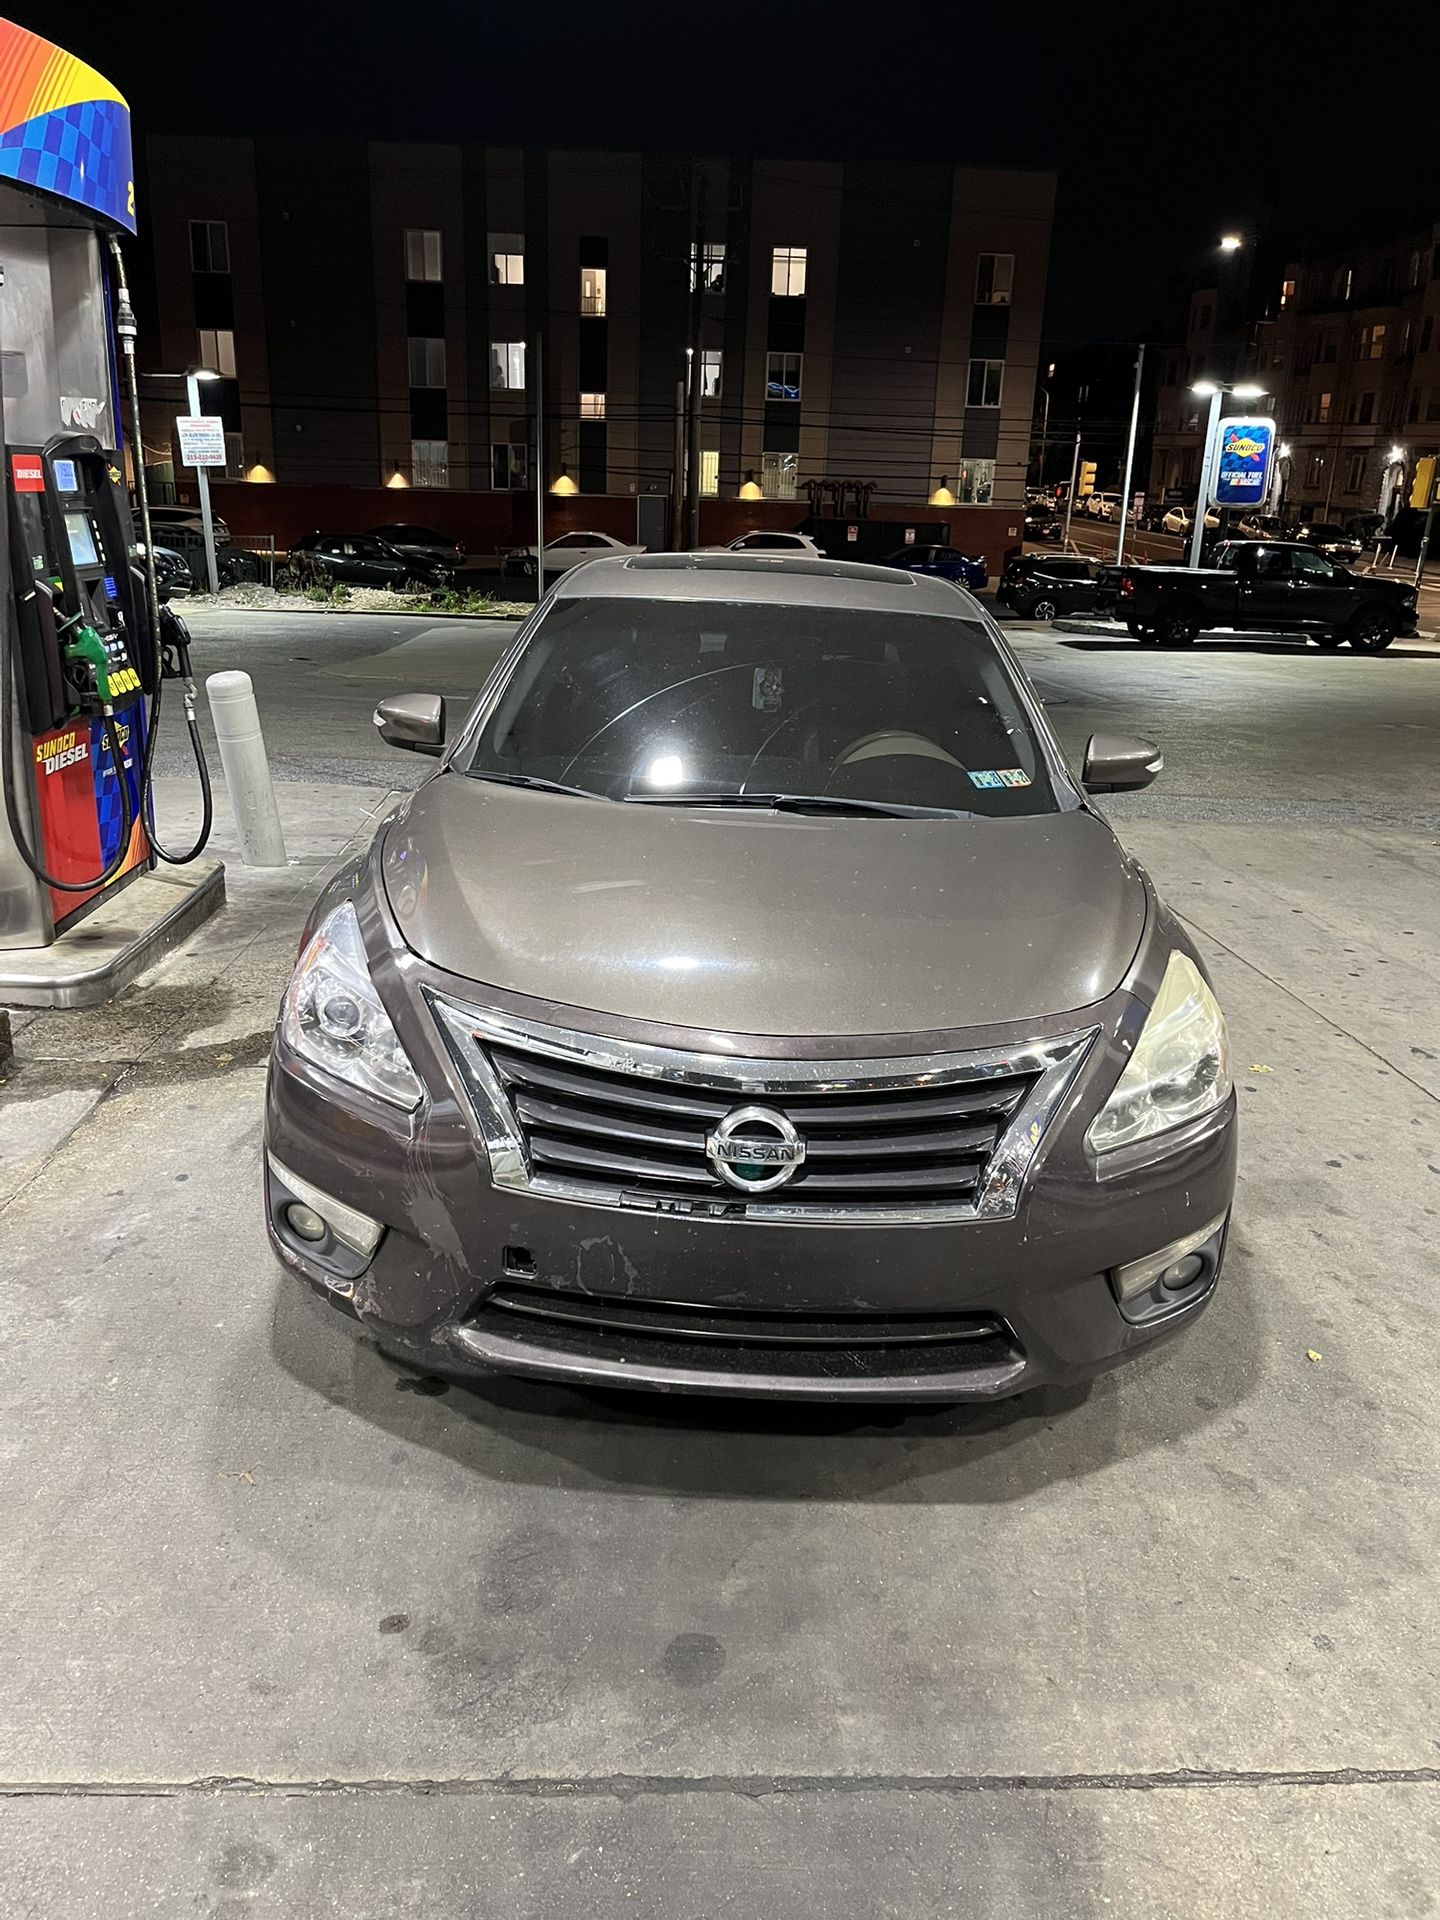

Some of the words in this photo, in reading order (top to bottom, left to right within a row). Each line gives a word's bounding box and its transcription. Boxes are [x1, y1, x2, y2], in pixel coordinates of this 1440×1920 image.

[1226, 444, 1265, 452] SUNOCO
[16, 469, 42, 479] DIESEL
[1247, 472, 1263, 480] FUEL
[36, 731, 76, 763] SUNOCO
[42, 743, 88, 776] DIESEL
[717, 1144, 795, 1161] NISSAN
